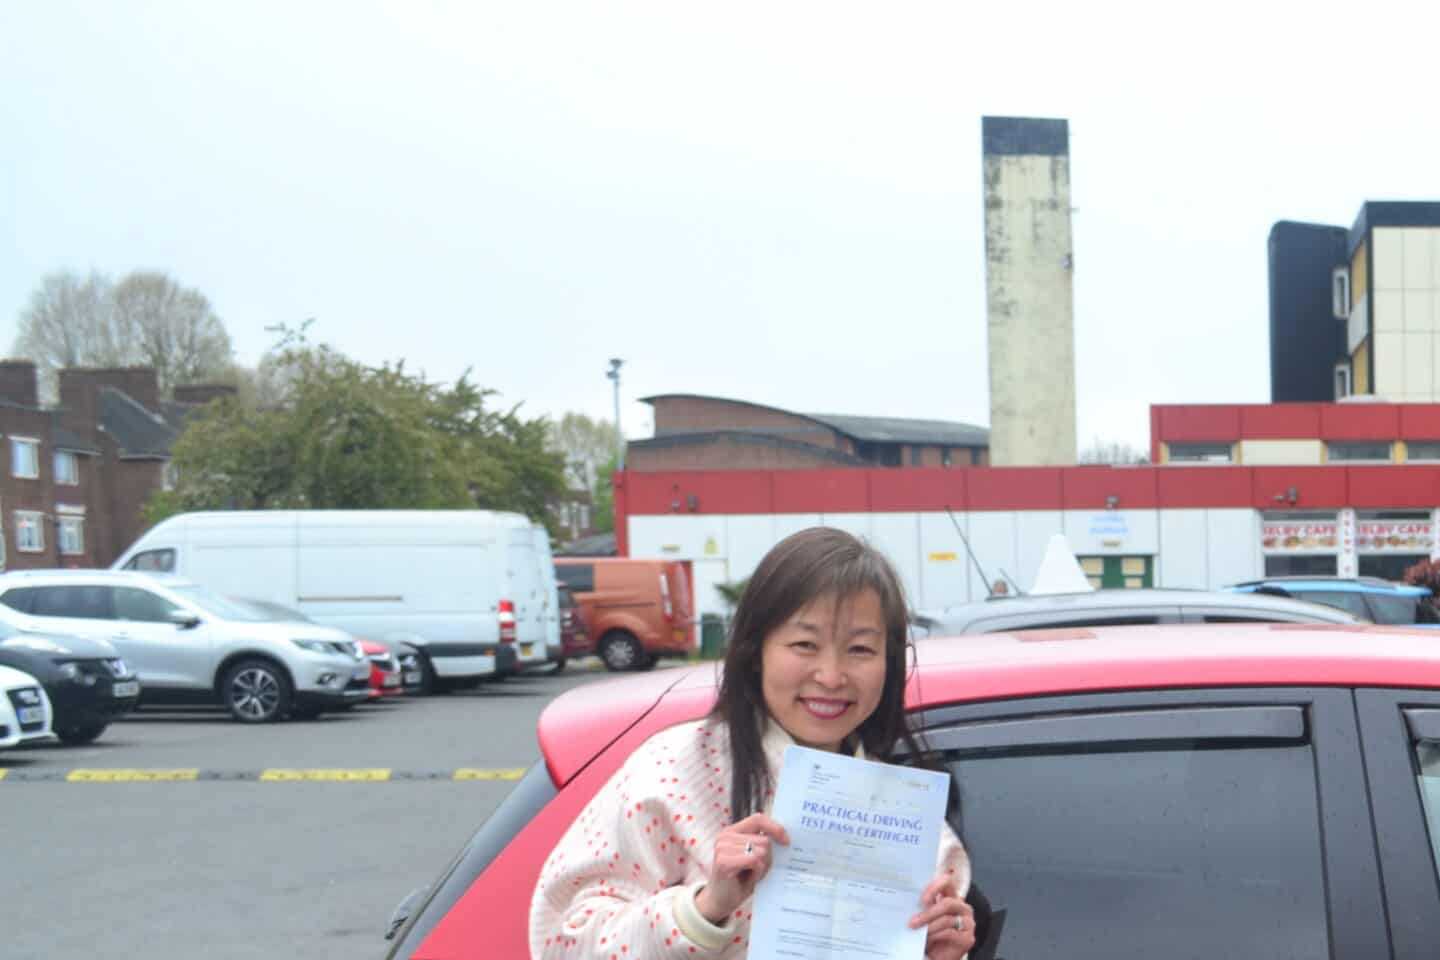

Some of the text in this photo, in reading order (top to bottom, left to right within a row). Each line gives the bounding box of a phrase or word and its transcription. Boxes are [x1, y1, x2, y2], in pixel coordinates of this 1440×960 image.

[800, 815, 824, 830] TEST
[828, 820, 855, 834] PASS
[855, 826, 921, 846] CERTIFICATE
[801, 800, 923, 832] PRACTICAL DRIVING
